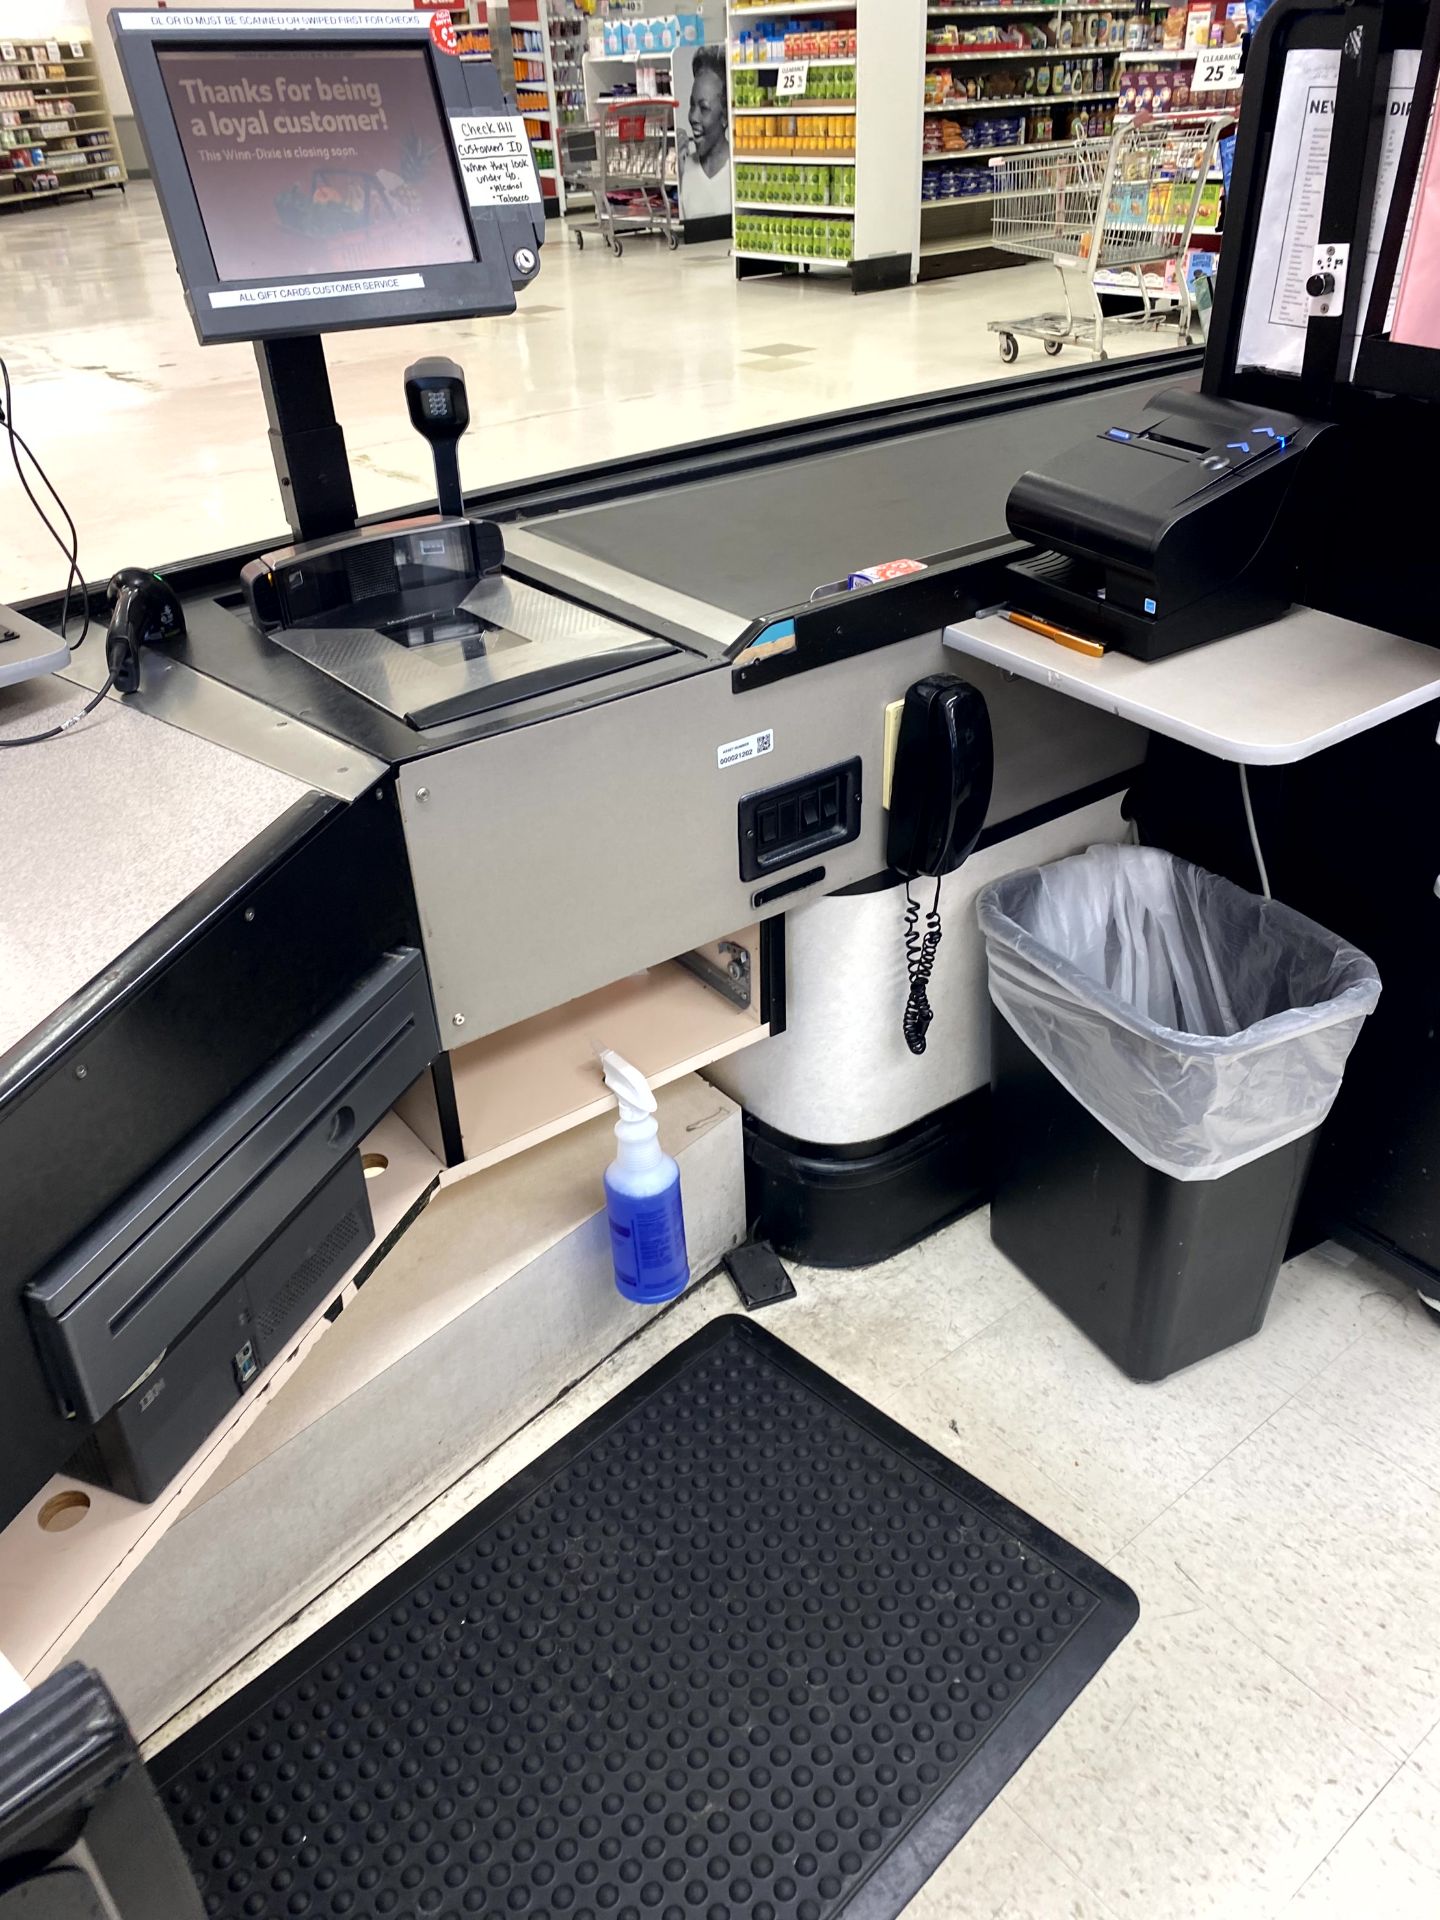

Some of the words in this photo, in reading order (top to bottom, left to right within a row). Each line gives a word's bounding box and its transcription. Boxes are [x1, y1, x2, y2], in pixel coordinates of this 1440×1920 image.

[151, 16, 163, 25] DL
[166, 16, 181, 25] OR
[184, 16, 193, 25] ID
[195, 16, 222, 25] MUST
[225, 16, 238, 25] BE
[239, 16, 285, 25] SCANNED
[286, 16, 300, 25] OR
[301, 16, 337, 25] SWIPED
[338, 16, 364, 25] FIRST
[365, 16, 384, 25] FOR
[385, 16, 421, 25] CHECKS
[1204, 65, 1225, 82] 25
[784, 75, 795, 88] 25
[178, 77, 273, 104] Thanks
[275, 76, 312, 102] for
[314, 76, 382, 107] being
[190, 118, 207, 137] a
[208, 109, 270, 143] loyal
[273, 107, 389, 135] customer!
[461, 122, 495, 137] Check
[497, 122, 513, 133] All
[199, 149, 222, 162] This
[223, 147, 282, 161] Winn-Dixie
[284, 146, 292, 159] is
[294, 146, 330, 160] closing
[331, 146, 358, 157] soon.
[507, 141, 523, 153] ID
[490, 160, 509, 172] they
[511, 159, 529, 169] look
[476, 174, 502, 184] under
[239, 292, 256, 302] ALL
[257, 290, 278, 301] GIFT
[279, 288, 311, 299] CARDS
[312, 283, 362, 296] CUSTOMER
[362, 279, 400, 291] SERVICE
[140, 1378, 165, 1412] IBM
